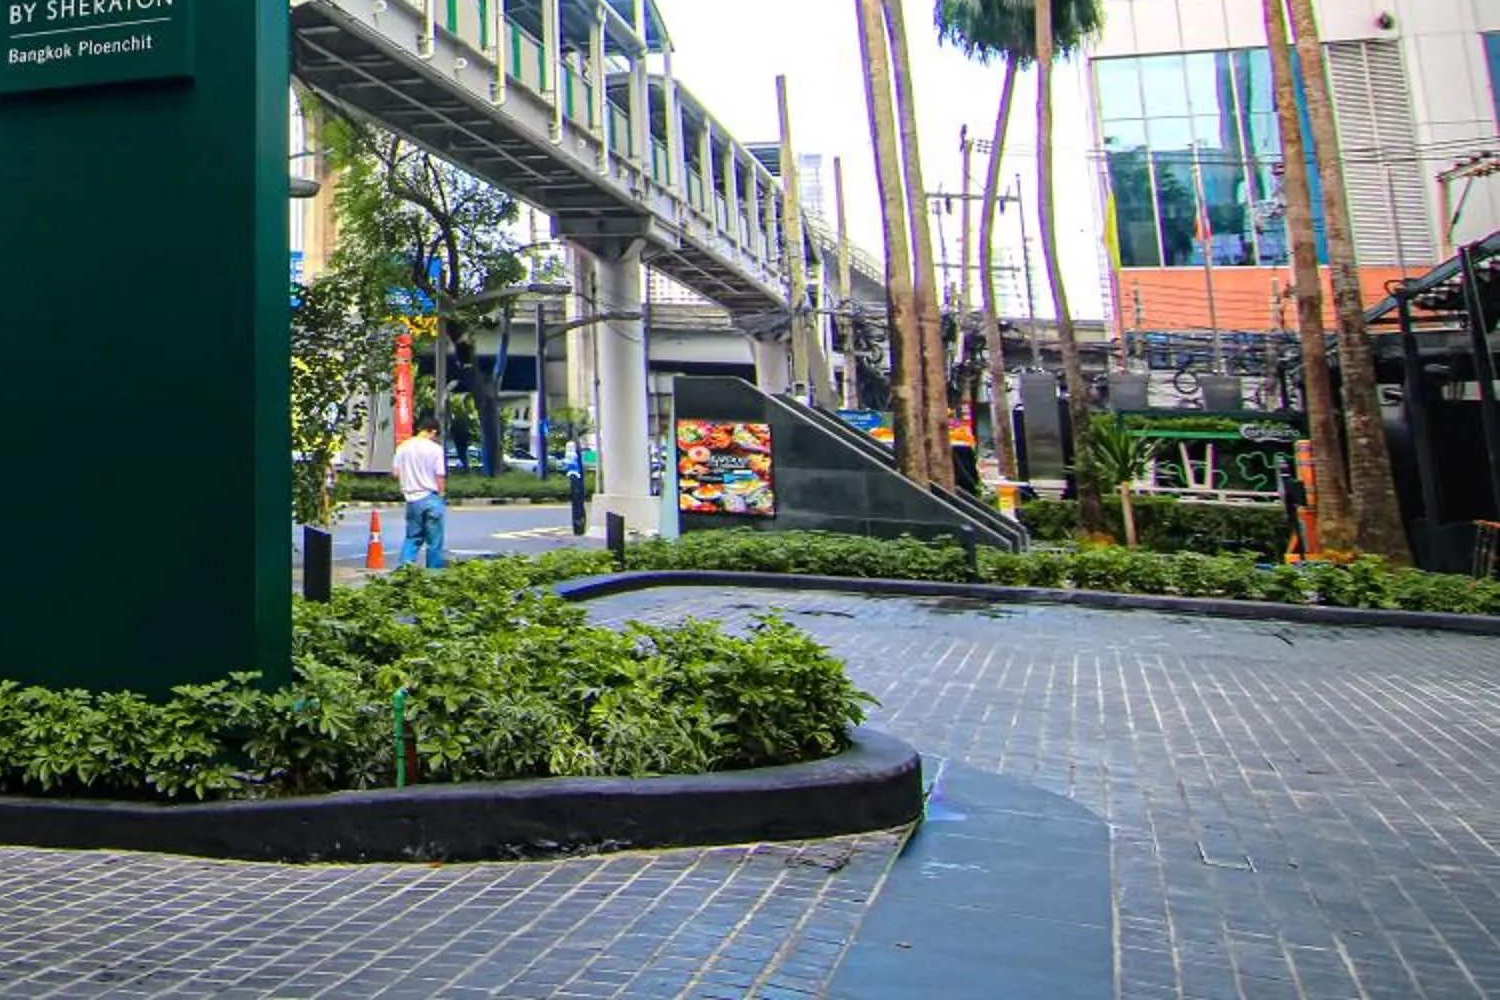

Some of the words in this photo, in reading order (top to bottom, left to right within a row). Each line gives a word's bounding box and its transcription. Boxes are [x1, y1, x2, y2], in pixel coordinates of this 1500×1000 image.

[8, 2, 38, 25] BY
[8, 43, 73, 65] Bangkok
[77, 33, 153, 57] Ploenchit
